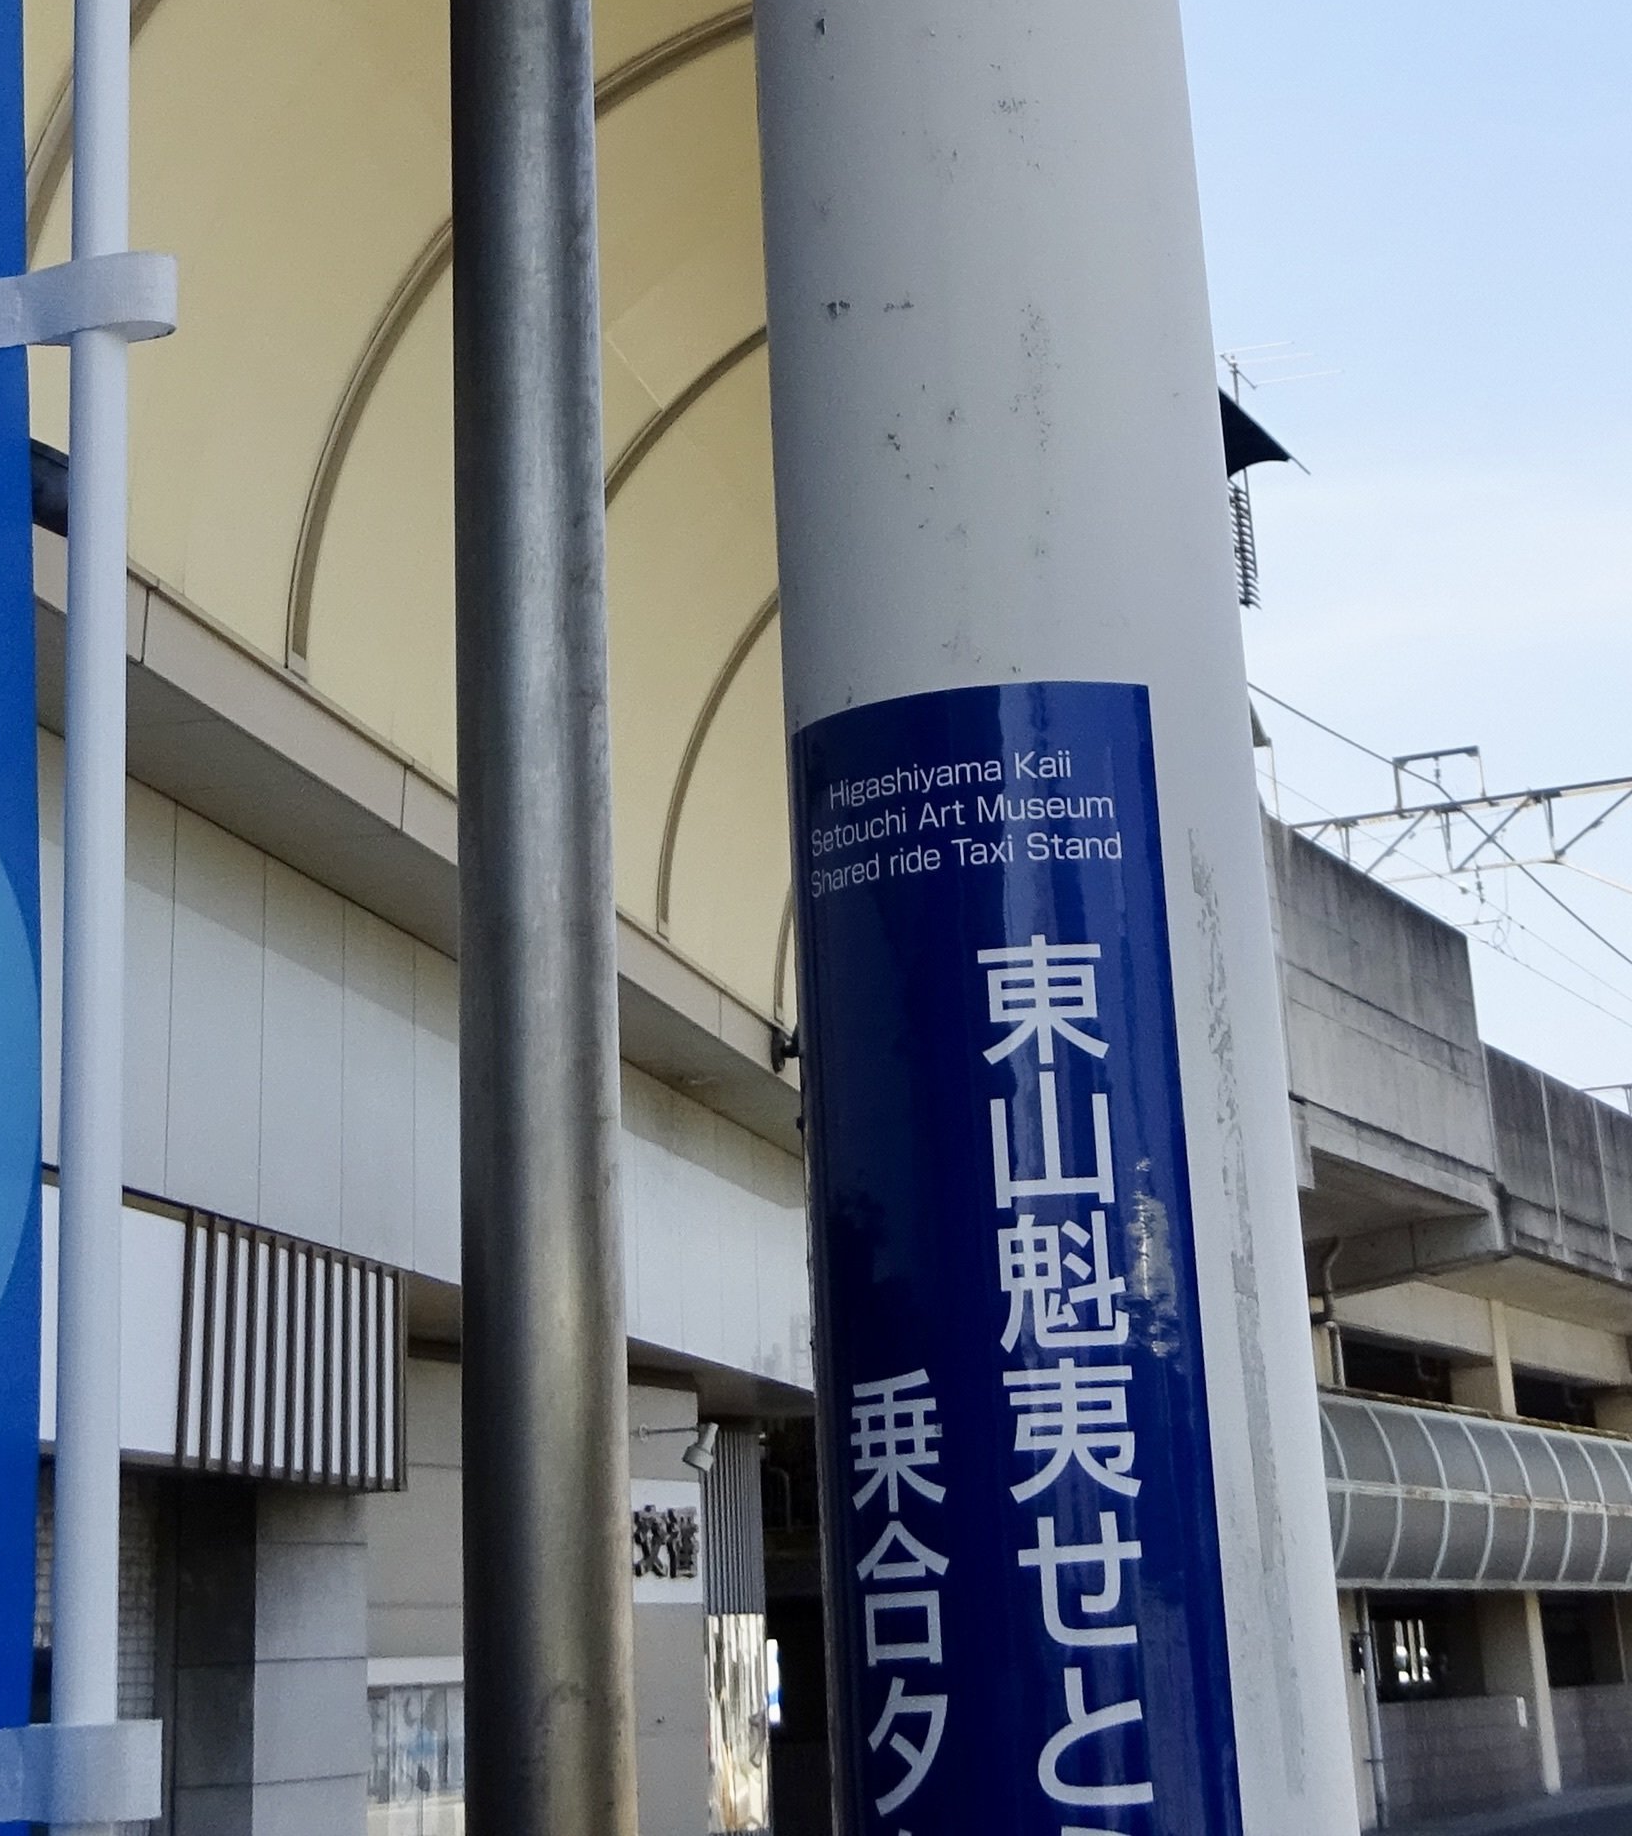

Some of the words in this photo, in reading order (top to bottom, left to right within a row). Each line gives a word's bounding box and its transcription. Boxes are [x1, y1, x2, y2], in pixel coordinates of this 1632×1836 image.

[829, 756, 1003, 810] Higashiyama
[1014, 750, 1072, 780] Kaii
[811, 812, 907, 858] Setouchi
[919, 798, 965, 830] Art
[977, 793, 1114, 824] Museum
[810, 857, 880, 899] Shared
[889, 845, 941, 877] ride
[952, 834, 1014, 867] Taxi
[1027, 832, 1123, 862] Stand
[976, 933, 1155, 1836] 東山魁夷せと
[851, 1368, 950, 1836] 乗合タ
